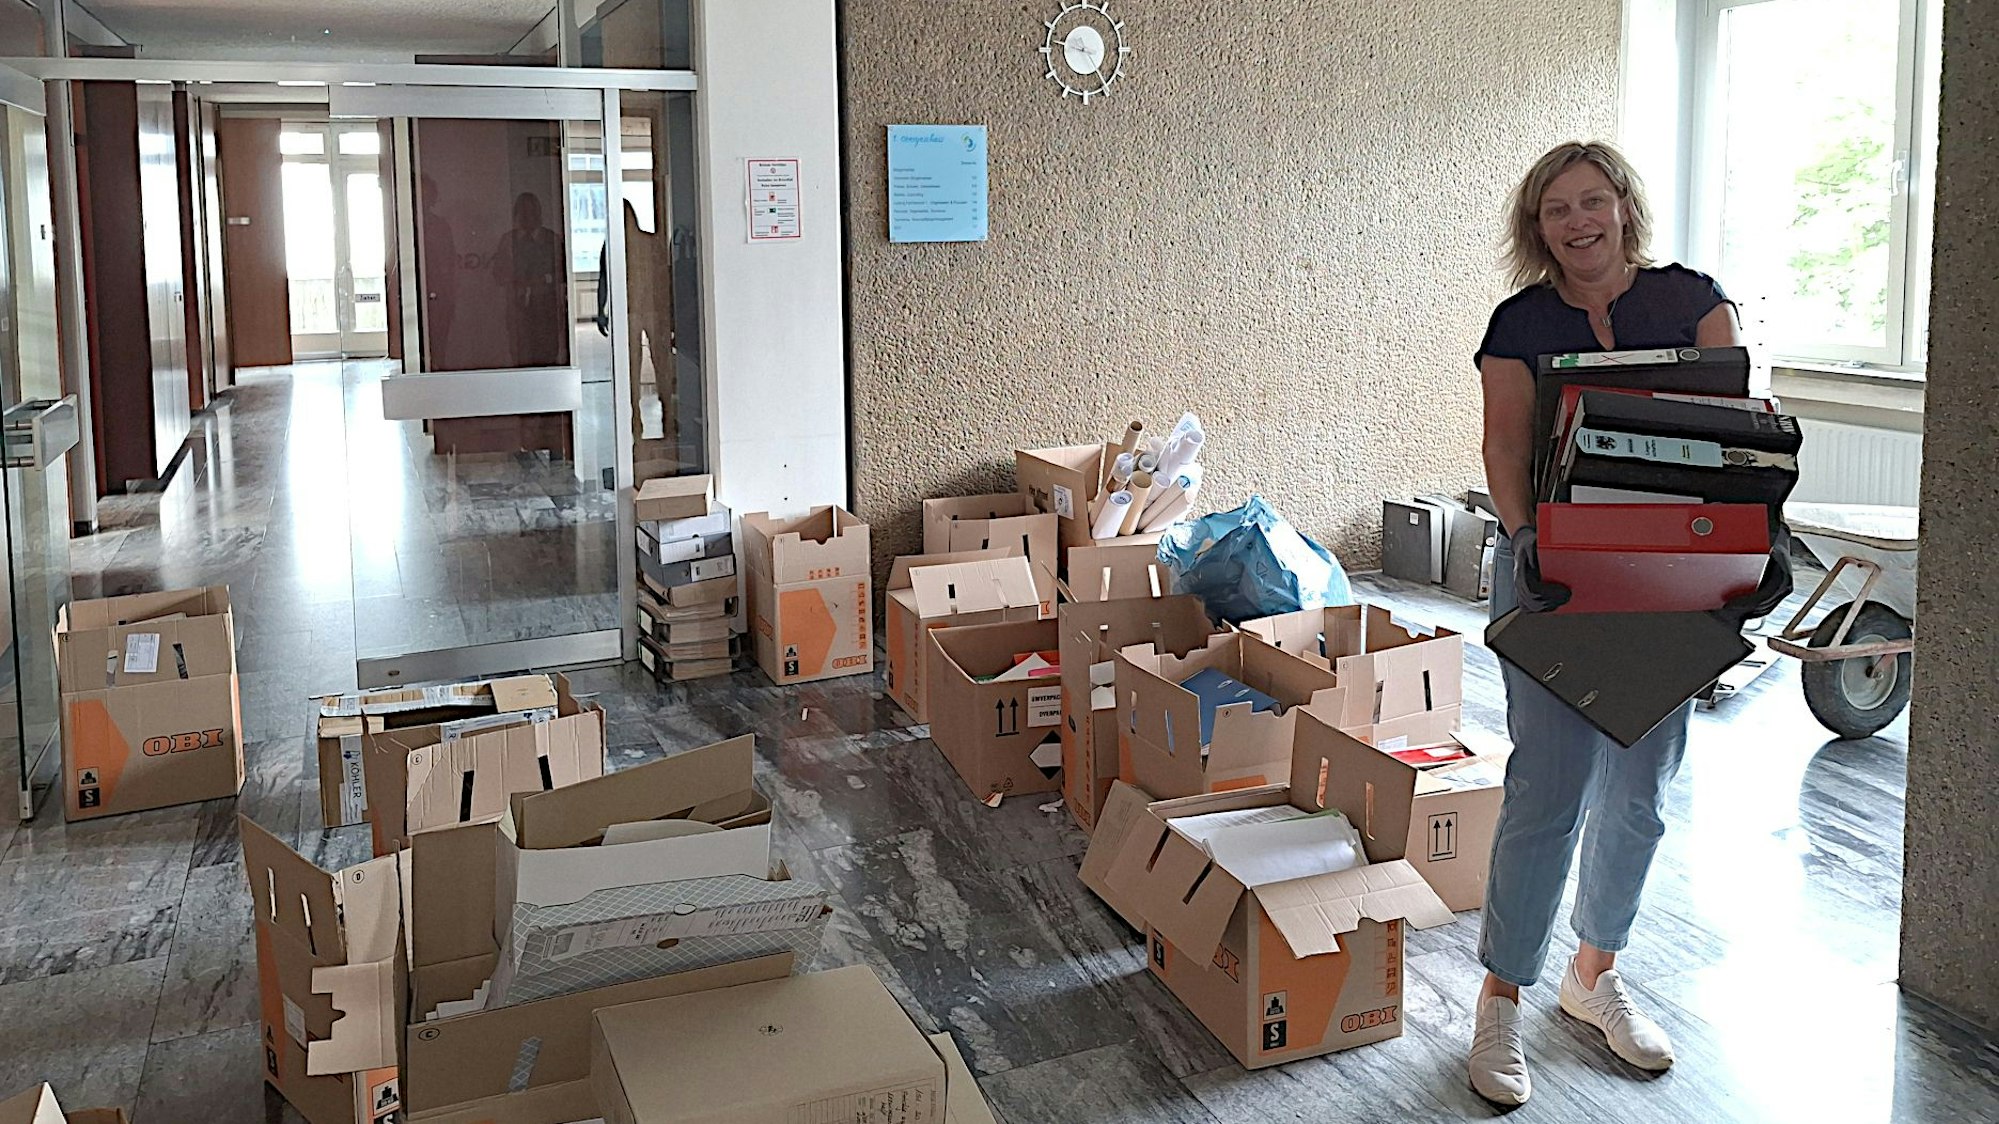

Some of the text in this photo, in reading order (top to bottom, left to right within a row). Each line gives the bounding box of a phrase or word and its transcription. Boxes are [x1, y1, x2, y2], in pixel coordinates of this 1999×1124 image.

[788, 661, 796, 672] S
[142, 728, 224, 757] OBI
[84, 789, 94, 803] S
[1340, 1005, 1398, 1034] OBI
[1270, 1022, 1280, 1042] S
